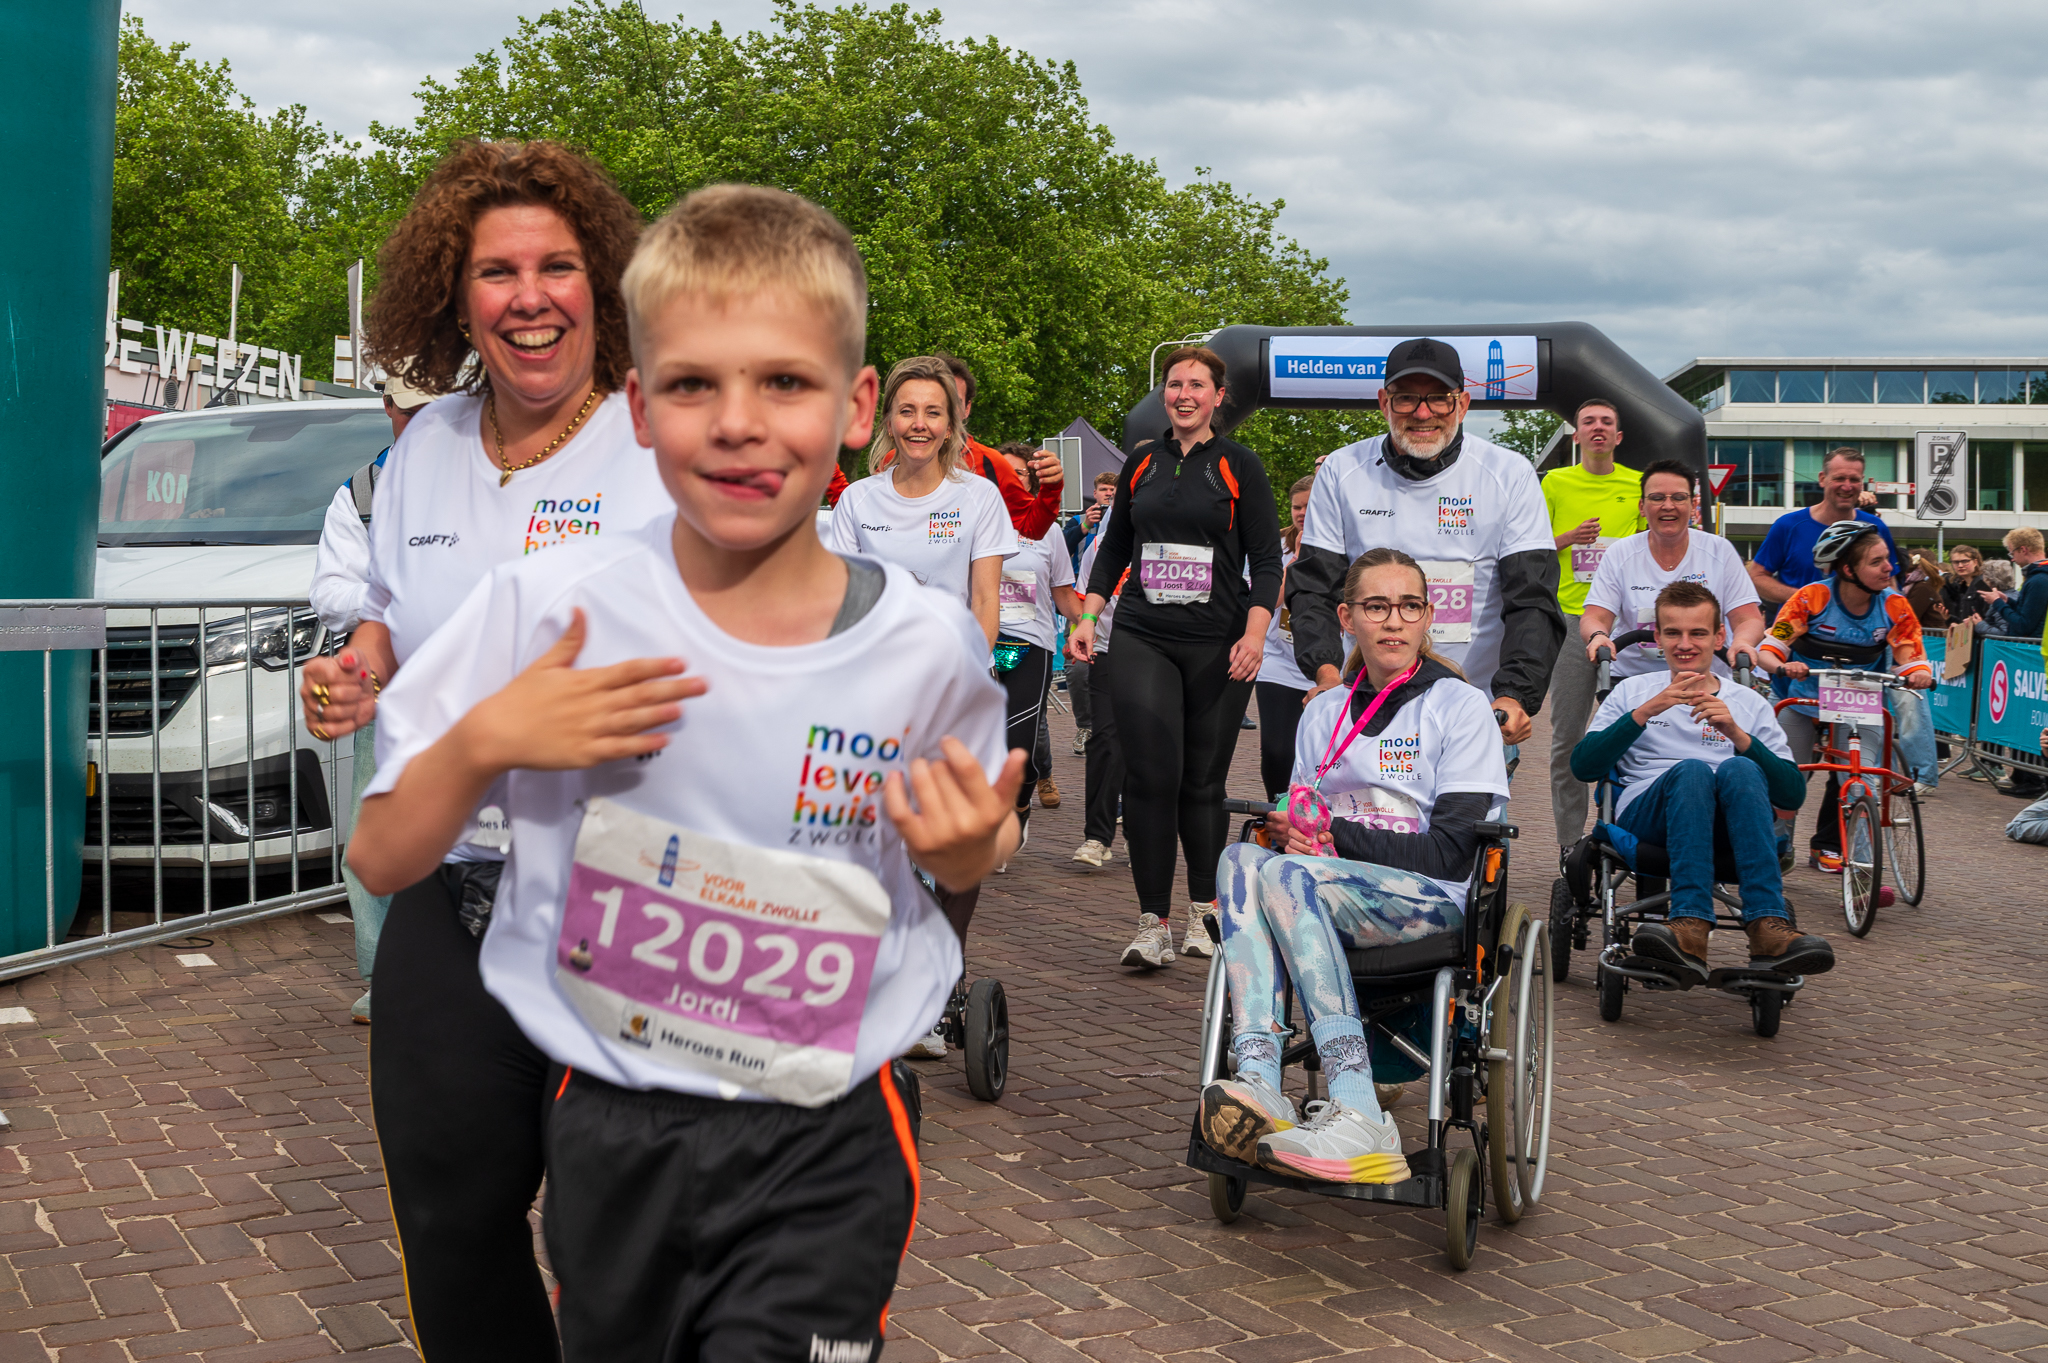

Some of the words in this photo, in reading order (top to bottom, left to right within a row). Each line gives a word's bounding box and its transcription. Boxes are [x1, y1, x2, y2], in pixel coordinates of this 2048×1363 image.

[156, 324, 301, 400] WEEZEN
[1287, 360, 1344, 375] Helden
[1347, 363, 1377, 375] van
[1934, 445, 1949, 462] P
[534, 493, 603, 514] mooi
[1438, 494, 1472, 506] mooi
[929, 508, 960, 520] mooi
[1359, 509, 1389, 517] CRAFT
[1438, 506, 1474, 517] leven
[527, 515, 600, 536] leven
[861, 523, 885, 532] CRAFT
[929, 520, 962, 529] leven
[1438, 516, 1467, 528] huis
[408, 534, 450, 546] CRAFT
[928, 528, 955, 538] huis
[1575, 551, 1605, 564] 120
[1146, 562, 1208, 581] 12043
[1163, 582, 1183, 590] Joost
[1823, 689, 1879, 706] 12003
[806, 725, 911, 762] mooi
[1380, 733, 1419, 747] mooi
[1702, 732, 1726, 742] huis
[1380, 749, 1419, 760] leven
[1380, 761, 1412, 773] huis
[800, 754, 883, 796] leve
[1380, 773, 1422, 781] ZWOLLE
[793, 791, 876, 828] huis
[703, 872, 746, 893] VOOR
[700, 887, 758, 913] ELKAAR
[760, 902, 822, 924] ZWOLLE
[590, 885, 855, 1008] 12029
[662, 983, 742, 1024] Jordi
[659, 1027, 725, 1060] Heroes
[728, 1050, 767, 1073] Run
